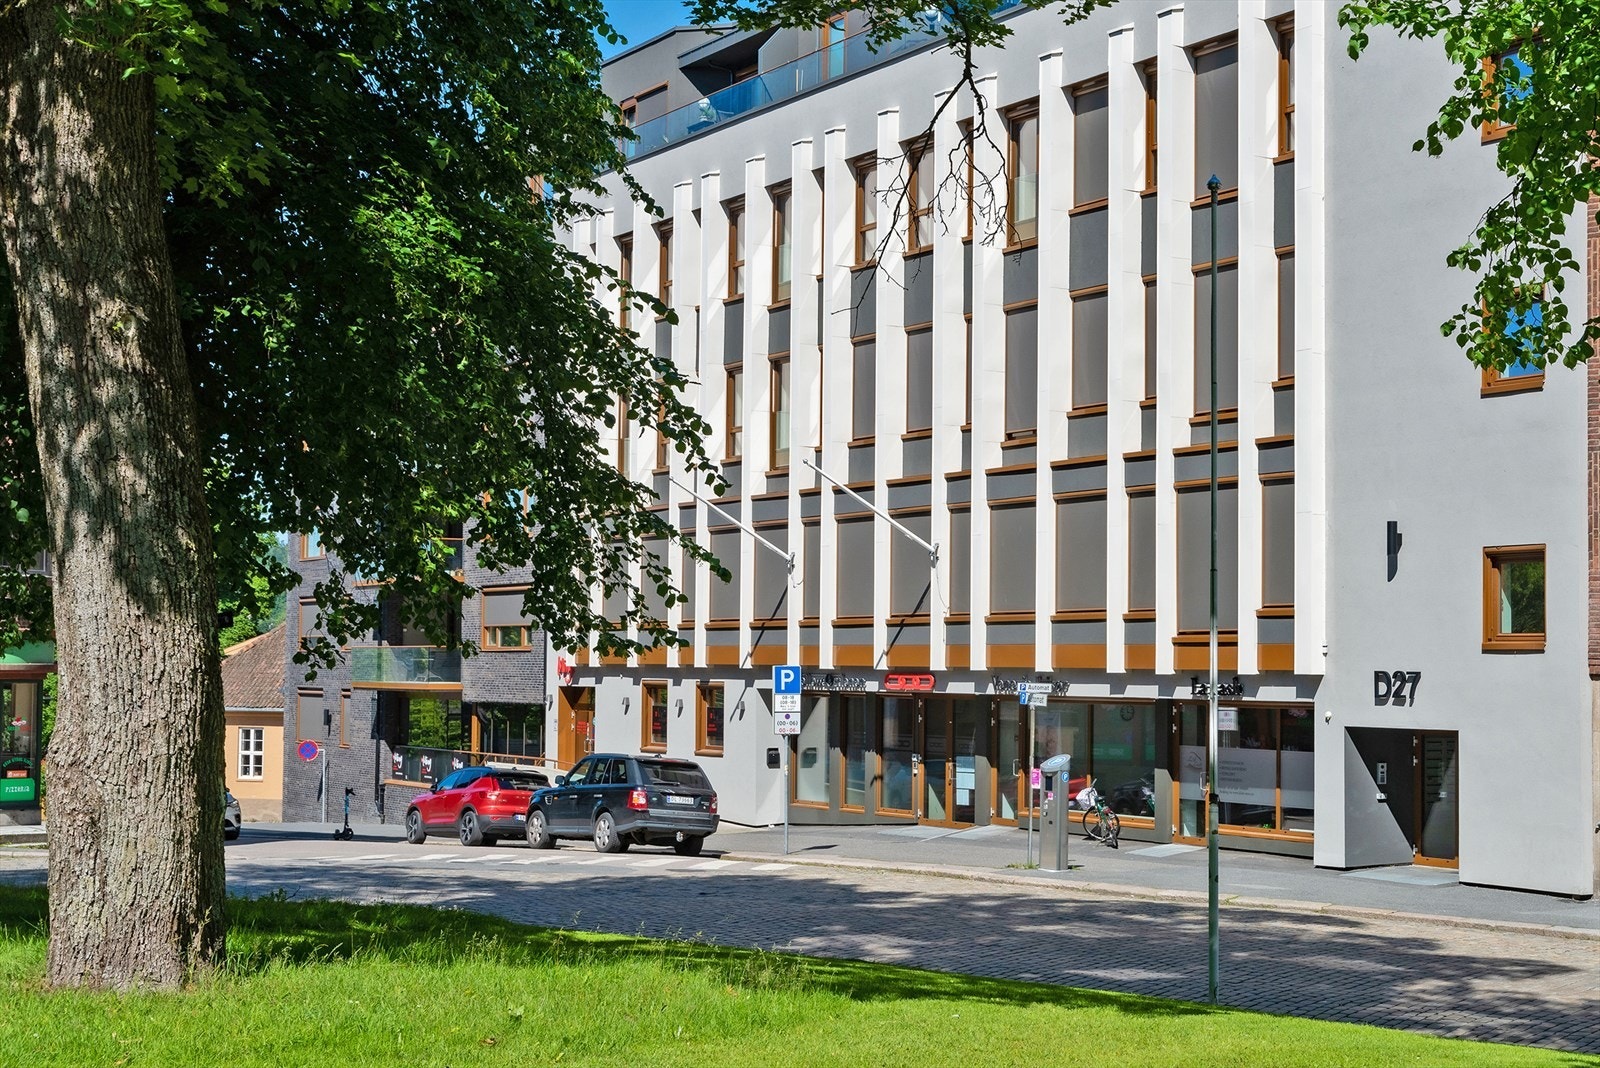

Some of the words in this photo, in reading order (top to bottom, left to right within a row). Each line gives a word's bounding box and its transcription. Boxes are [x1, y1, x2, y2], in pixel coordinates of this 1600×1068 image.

[780, 669, 795, 691] P
[1027, 683, 1050, 691] Automat
[1374, 670, 1421, 707] D27
